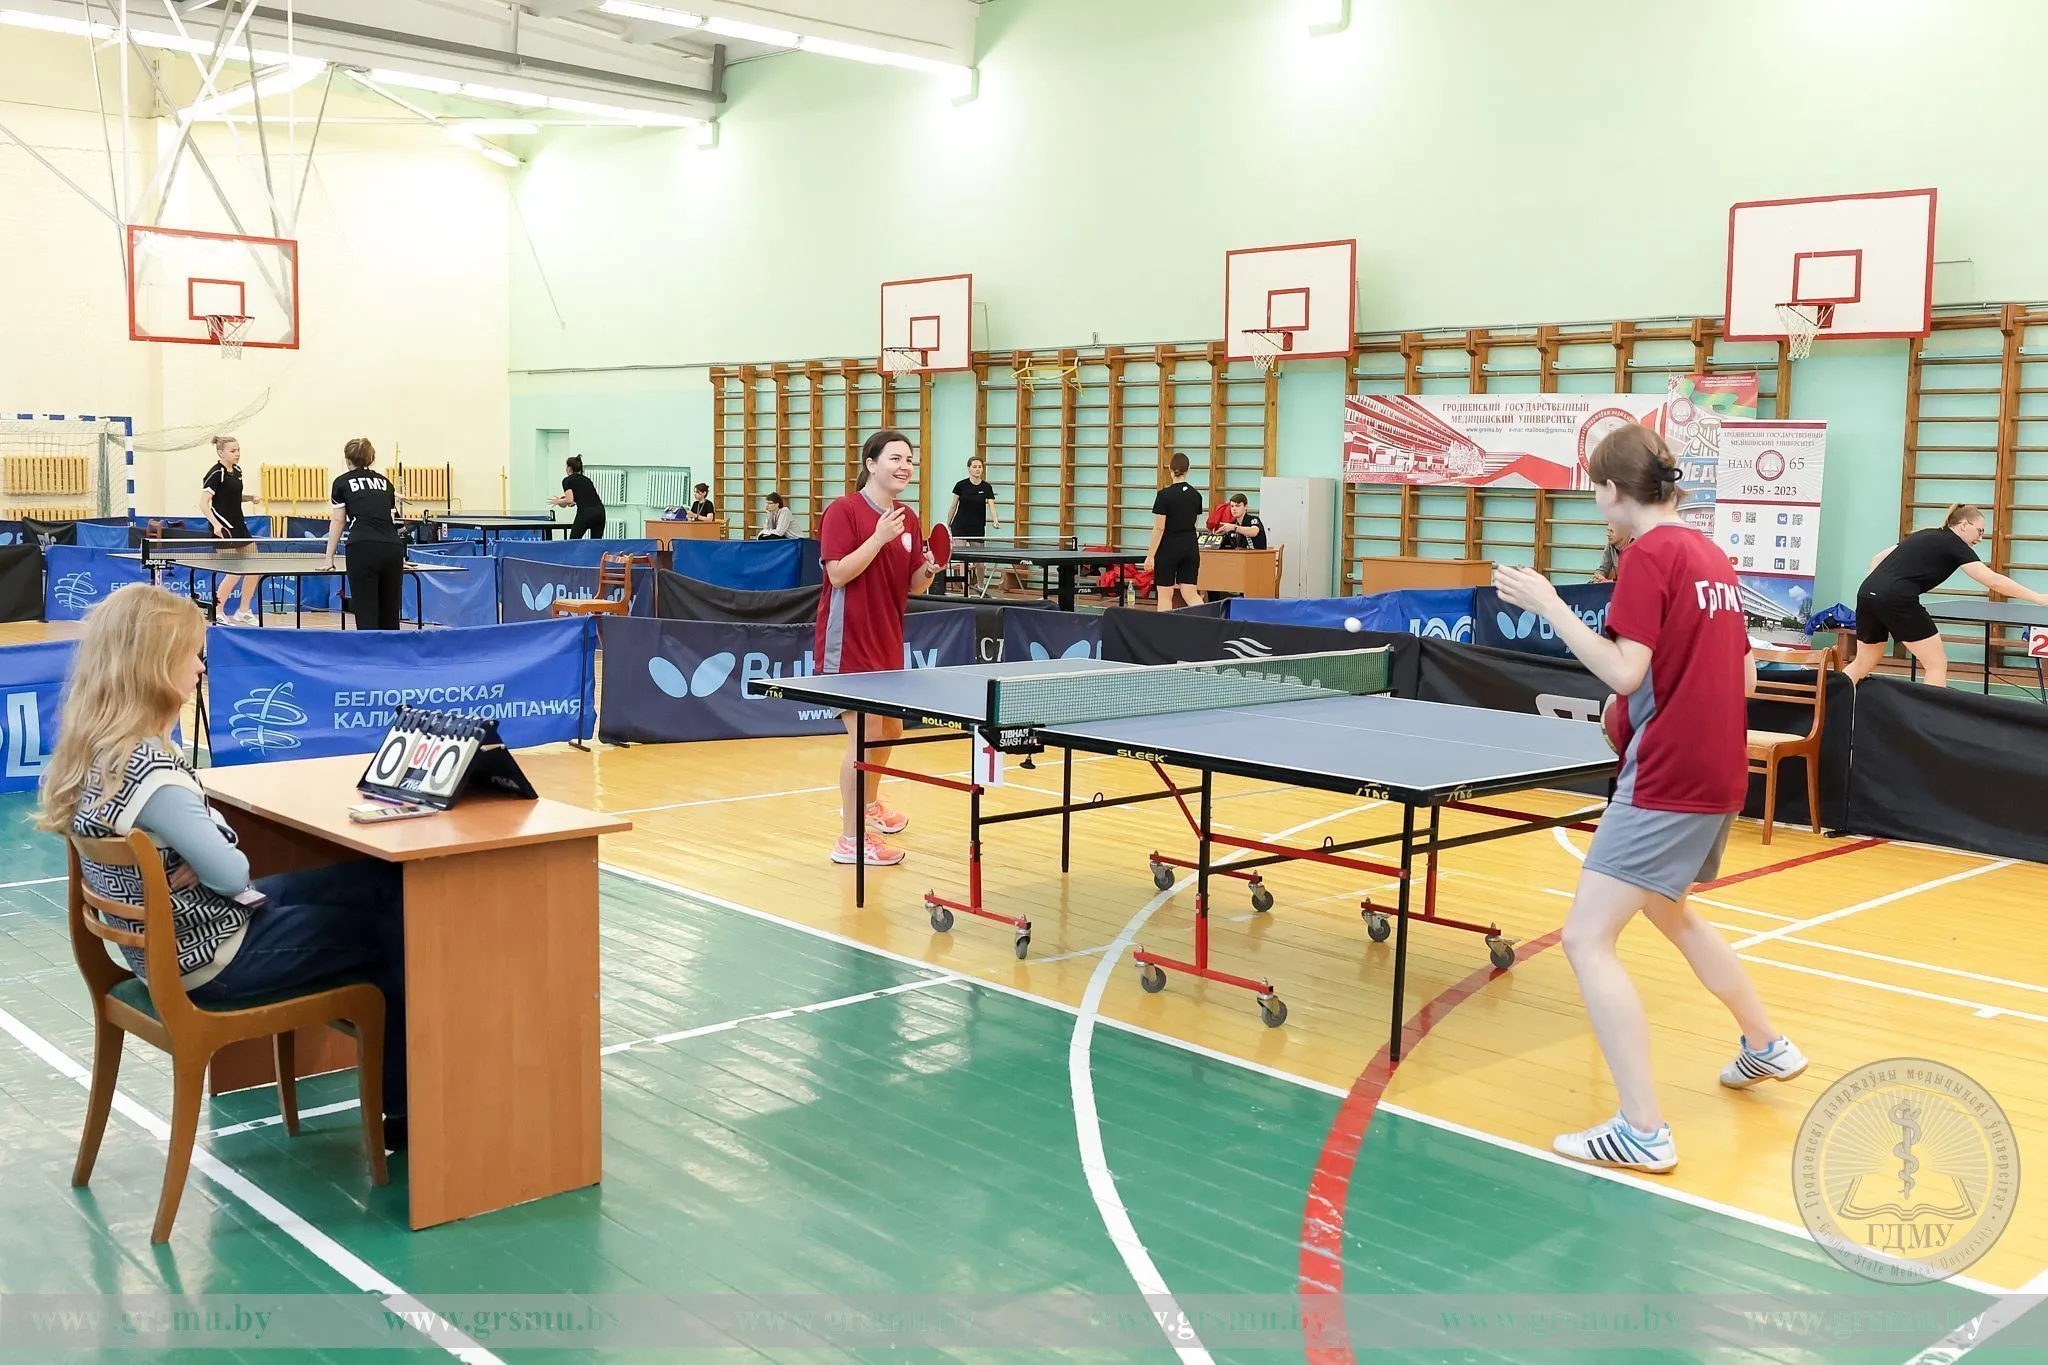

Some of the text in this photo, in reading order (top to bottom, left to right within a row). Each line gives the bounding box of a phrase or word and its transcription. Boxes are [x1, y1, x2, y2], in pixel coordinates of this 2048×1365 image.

[1442, 402, 1589, 412] ГРОДНЕНСКИЙ ГОСУДАРСТВЕННЫЙ
[1451, 414, 1577, 424] МЕДИЦИНСКИЙ УНИВЕРСИТЕТ
[1728, 457, 1805, 470] НАМ 65
[348, 477, 387, 492] БГМУ
[1742, 485, 1765, 494] 1958
[1774, 486, 1797, 496] 2023
[2031, 634, 2048, 656] 2
[334, 683, 505, 708] БЕЛОРУССКАЯ
[764, 686, 783, 698] STAG
[468, 699, 582, 720] КОМПАНИЯ
[922, 717, 962, 729] ROLL-ON
[1000, 738, 1022, 747] SMASH
[376, 735, 406, 780] 0
[1116, 749, 1165, 763] SLEEK
[429, 745, 460, 791] 0
[983, 745, 995, 783] 1
[1355, 782, 1389, 800] STAG
